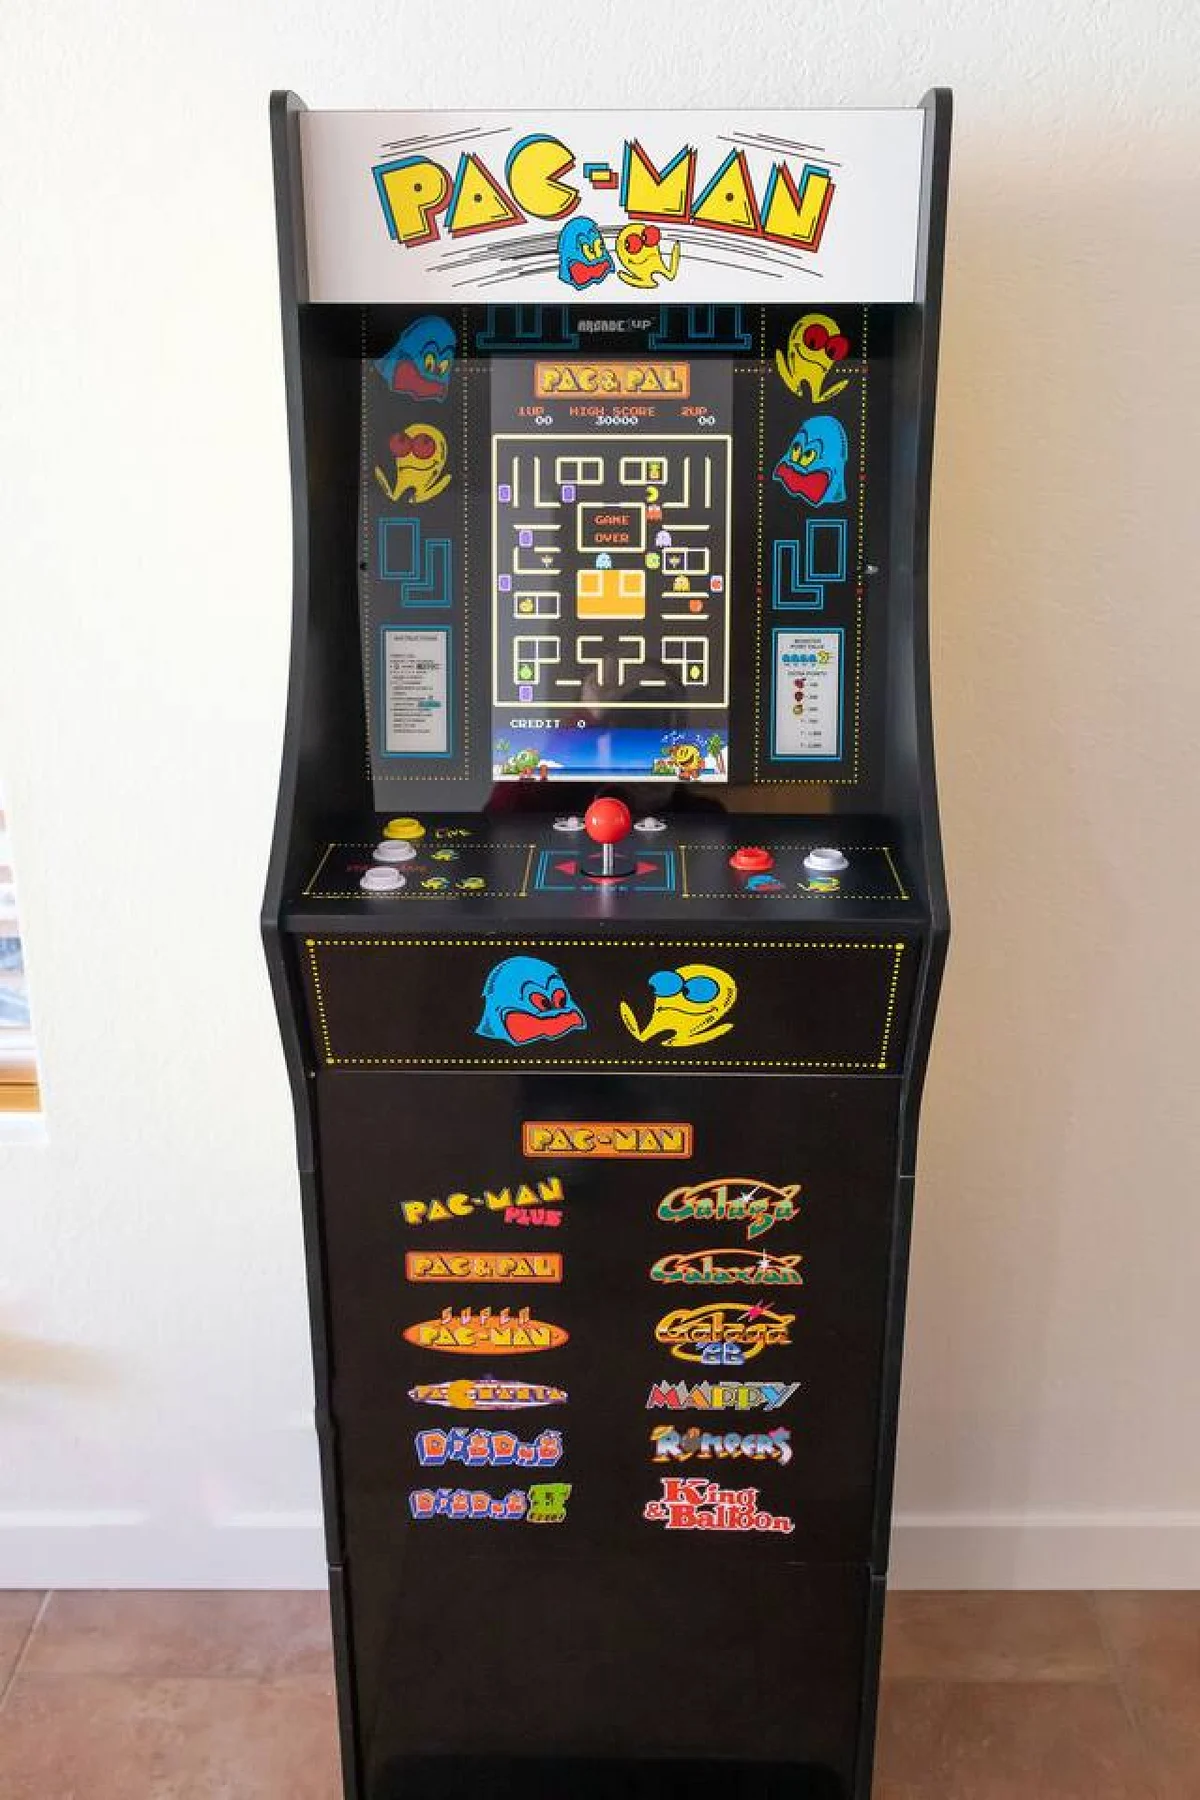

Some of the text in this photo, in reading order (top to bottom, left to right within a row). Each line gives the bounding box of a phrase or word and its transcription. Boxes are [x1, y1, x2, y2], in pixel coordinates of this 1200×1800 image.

[371, 133, 835, 253] PAC-MAN
[542, 367, 598, 393] PAC
[625, 367, 683, 393] PAL
[517, 406, 708, 417] 1UP HIGH SCORE 2UP
[534, 416, 553, 426] 00
[697, 416, 716, 426] 00
[593, 515, 631, 527] GAME
[593, 533, 631, 543] OVER
[509, 719, 586, 729] CREDIT 0
[530, 1127, 685, 1153] PAC-MAN
[401, 1176, 565, 1225] PAC-MAN
[504, 1206, 563, 1227] PLUS
[413, 1256, 471, 1278] PAC
[499, 1257, 557, 1278] PAL
[418, 1326, 552, 1348] PAC-MAN
[645, 1380, 801, 1411] MAPPY
[660, 1477, 760, 1515] King
[643, 1502, 796, 1534] & Balloon
